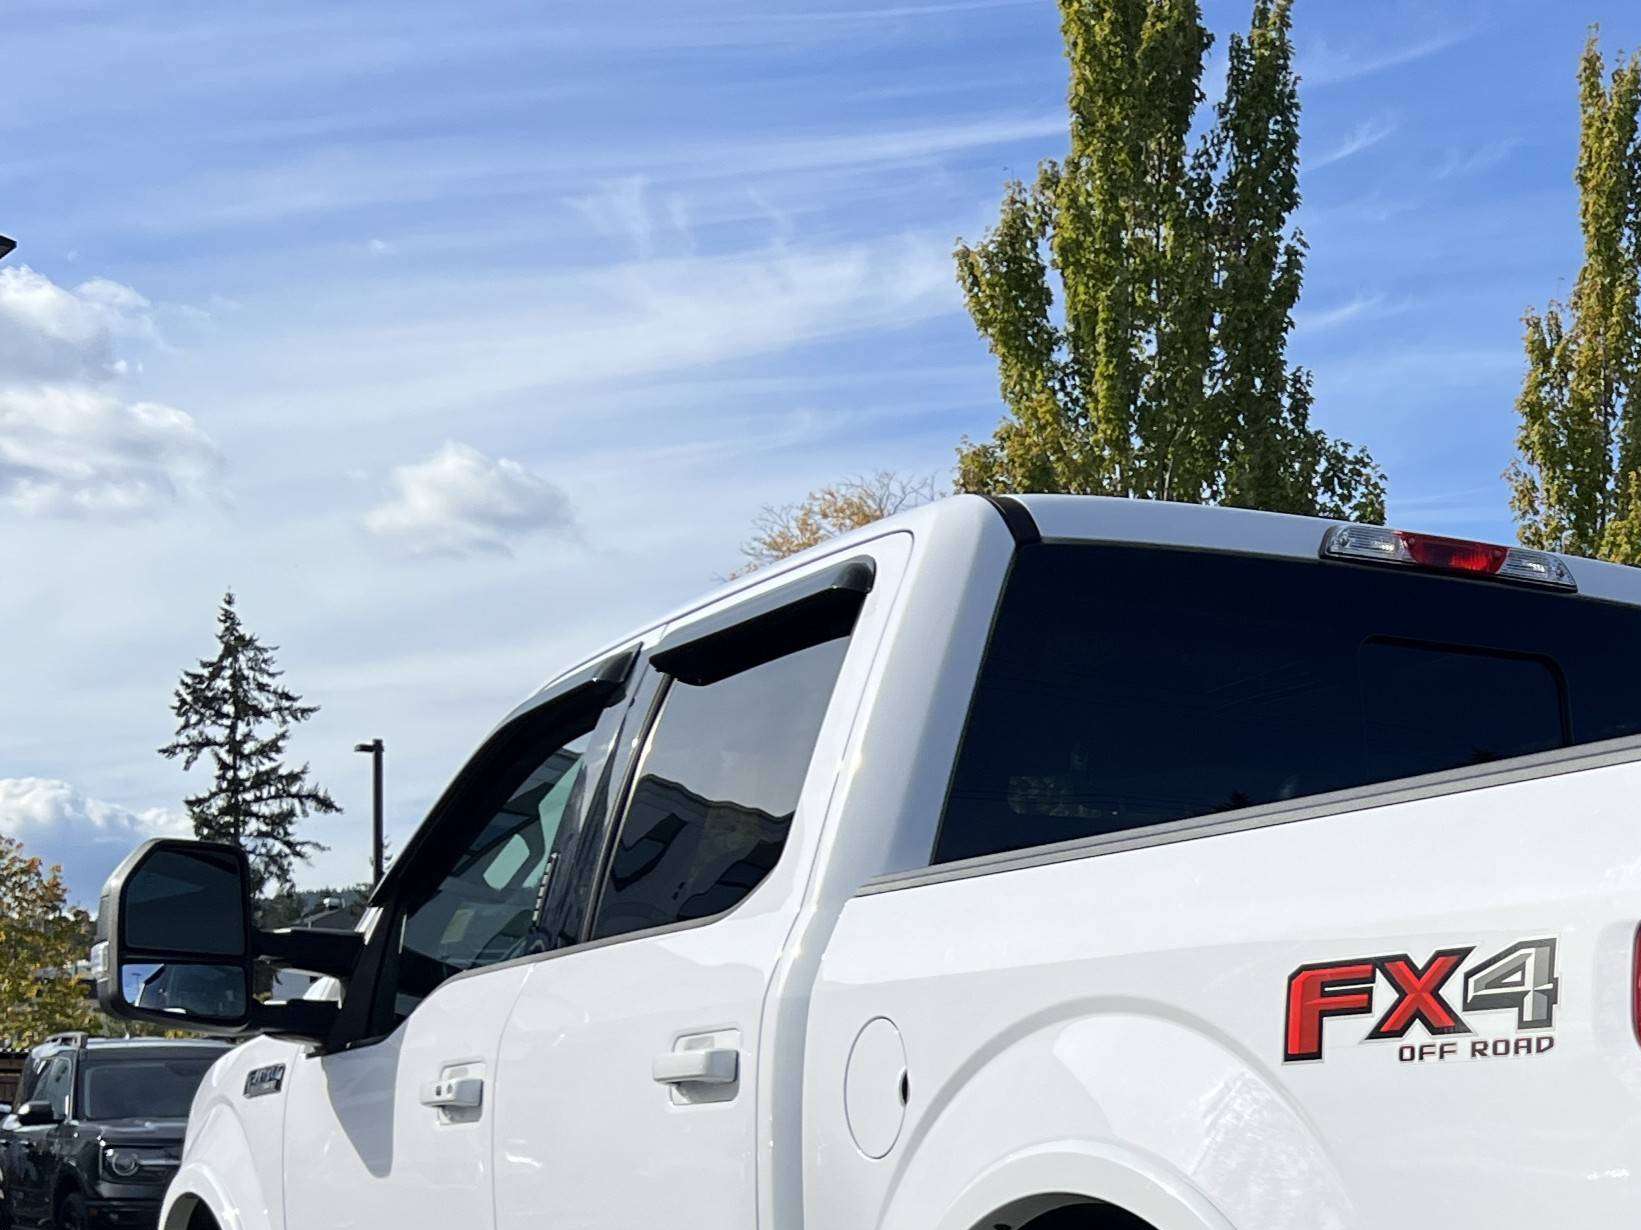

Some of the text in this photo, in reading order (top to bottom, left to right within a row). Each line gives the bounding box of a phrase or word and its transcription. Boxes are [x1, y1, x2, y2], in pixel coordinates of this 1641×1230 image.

[1282, 936, 1560, 1062] FX4
[1399, 1036, 1555, 1062] OFF ROAD
